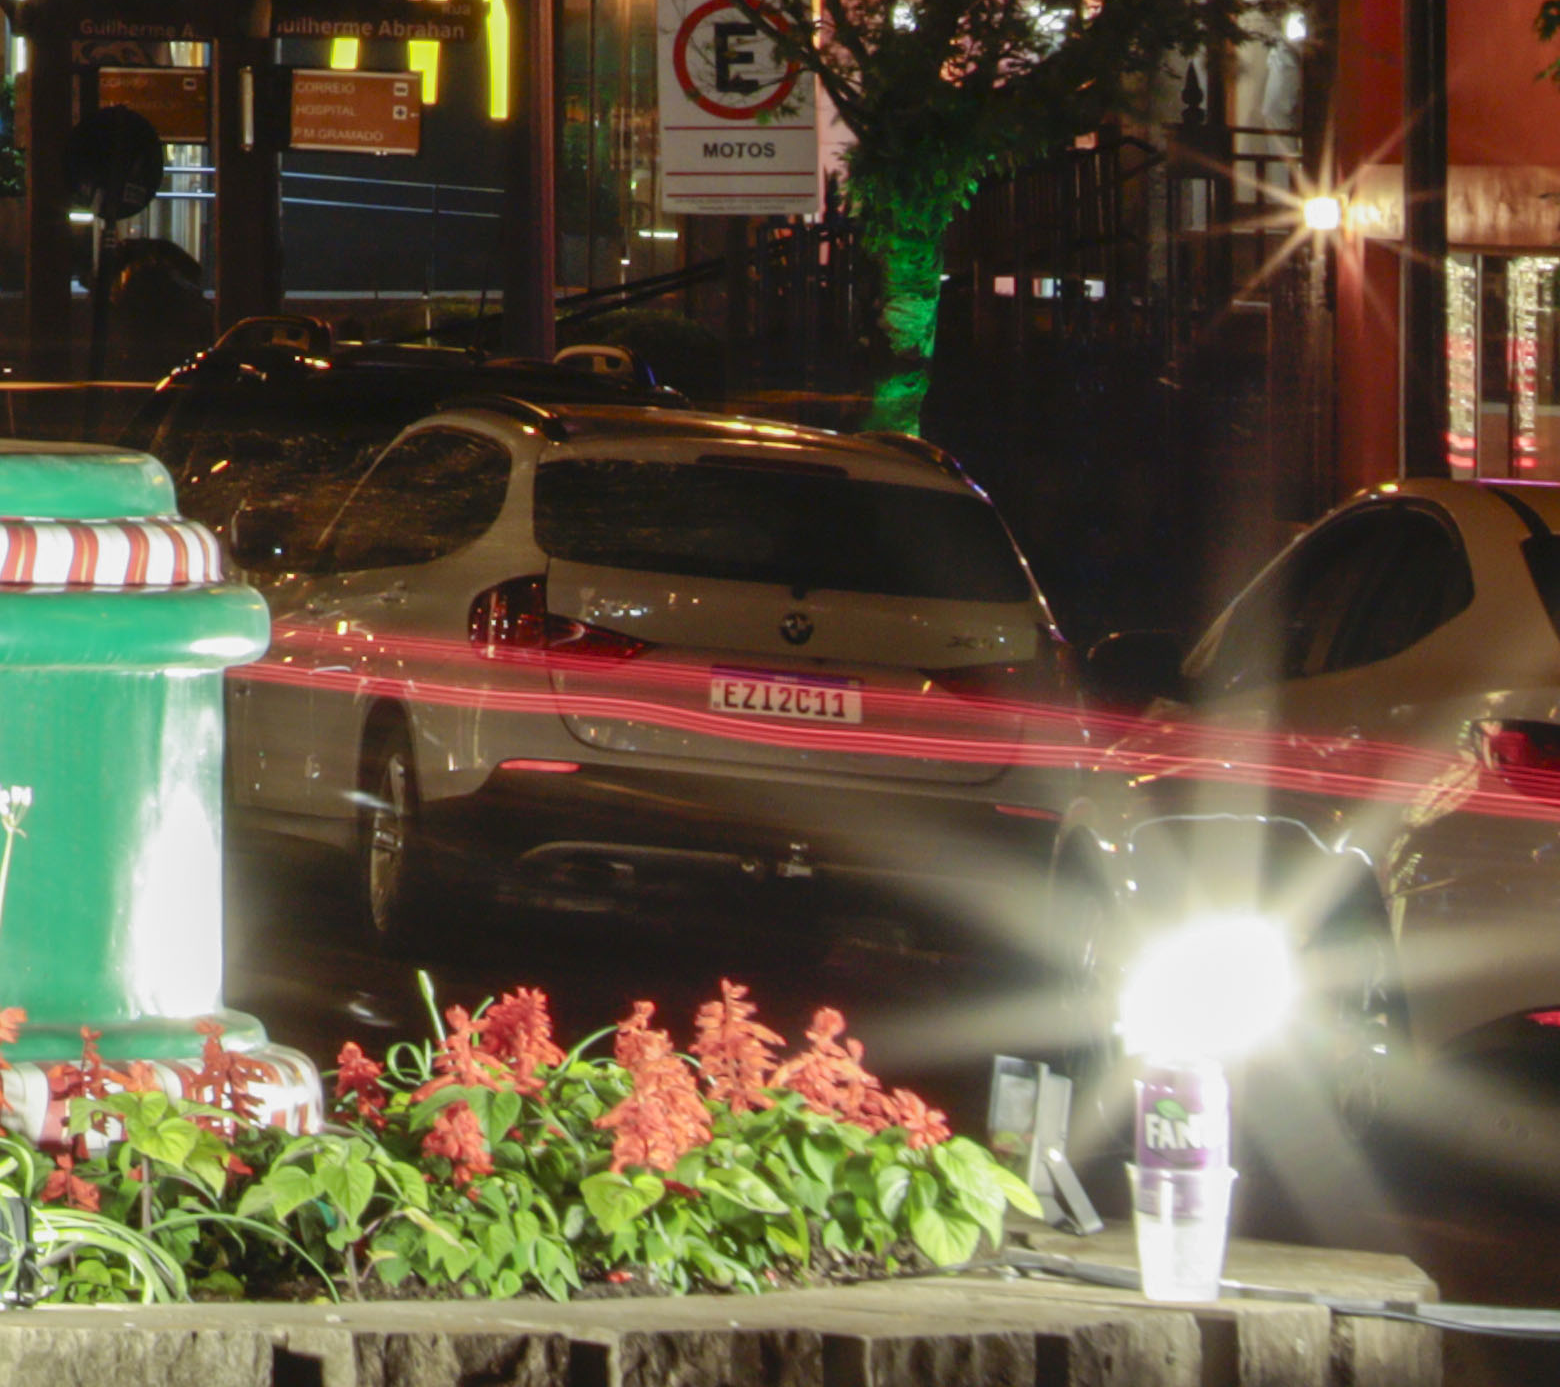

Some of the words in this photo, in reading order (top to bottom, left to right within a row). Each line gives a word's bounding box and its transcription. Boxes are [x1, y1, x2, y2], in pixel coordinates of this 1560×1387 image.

[277, 16, 373, 38] uilherme
[378, 19, 466, 40] Abrahan
[294, 81, 355, 95] CORREIO
[295, 103, 358, 117] HOSPITAL
[703, 142, 776, 159] MOTOS
[724, 682, 846, 718] EZI2C11
